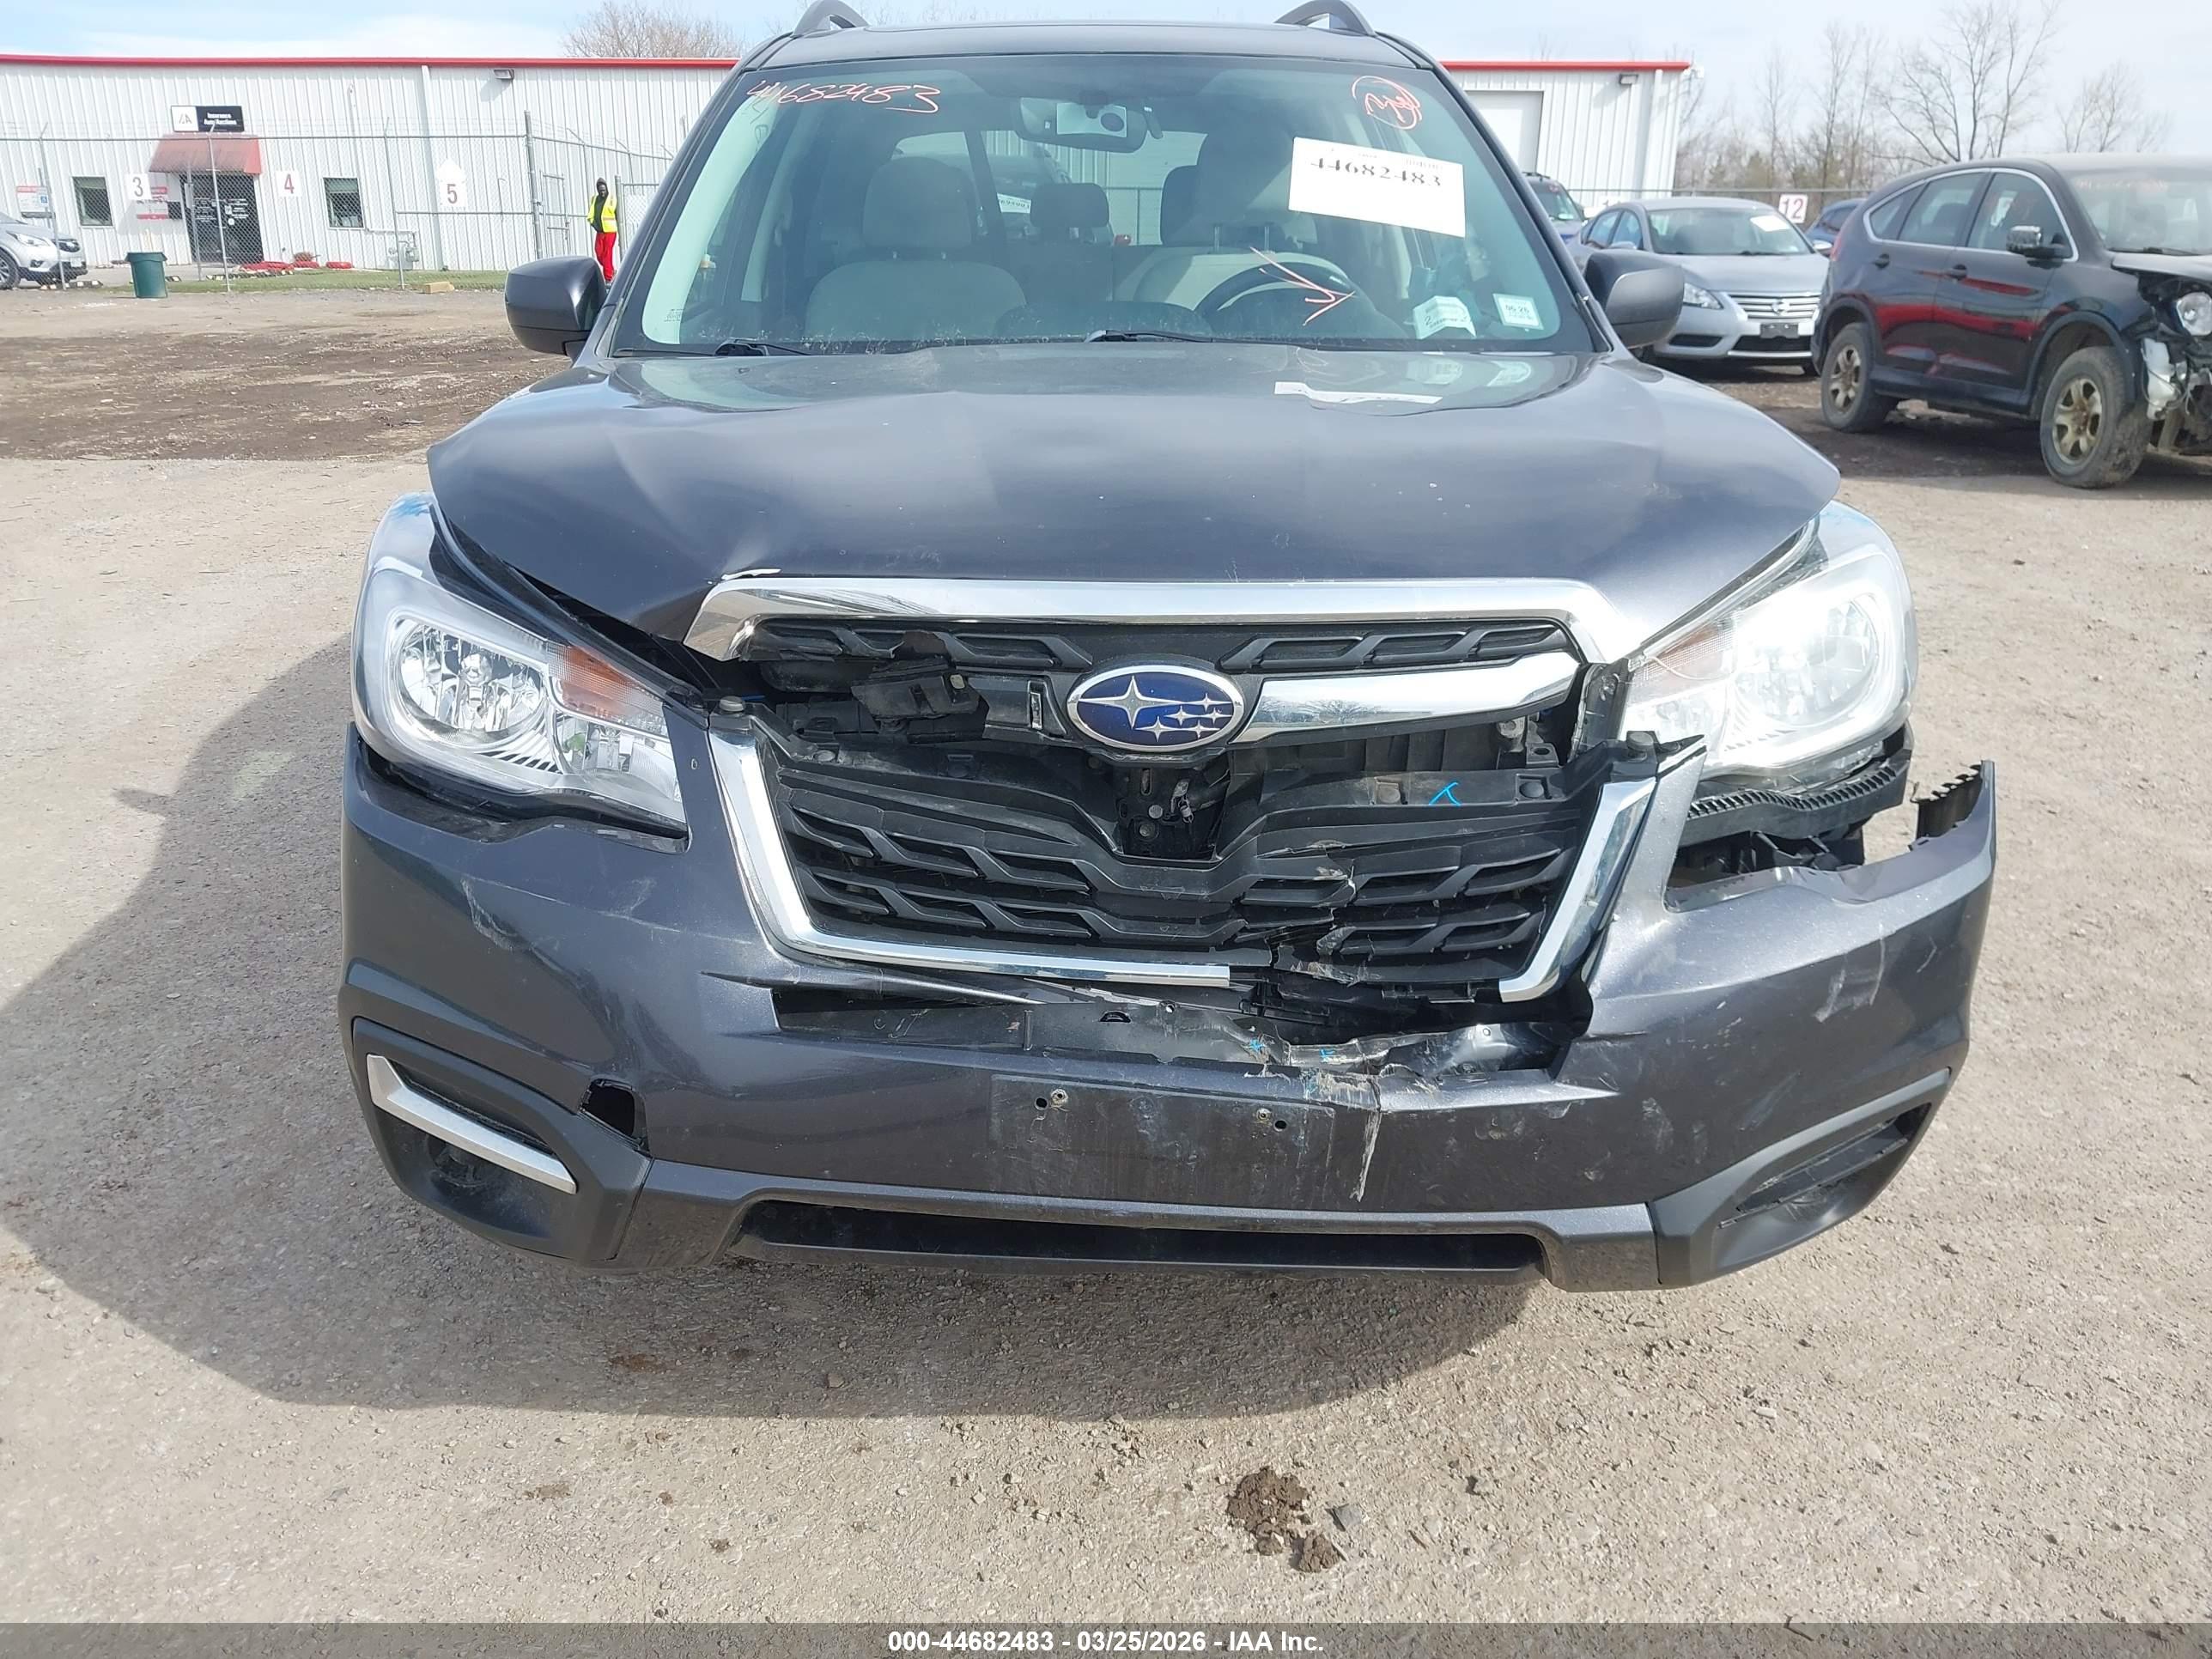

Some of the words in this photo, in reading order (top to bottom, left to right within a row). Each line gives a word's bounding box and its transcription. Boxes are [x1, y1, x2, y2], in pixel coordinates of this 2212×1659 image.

[747, 80, 941, 113] 44682483
[1310, 157, 1442, 187] 44682483
[132, 176, 143, 198] 3
[284, 173, 295, 195] 4
[447, 183, 458, 204] 5
[1783, 198, 1804, 219] 12
